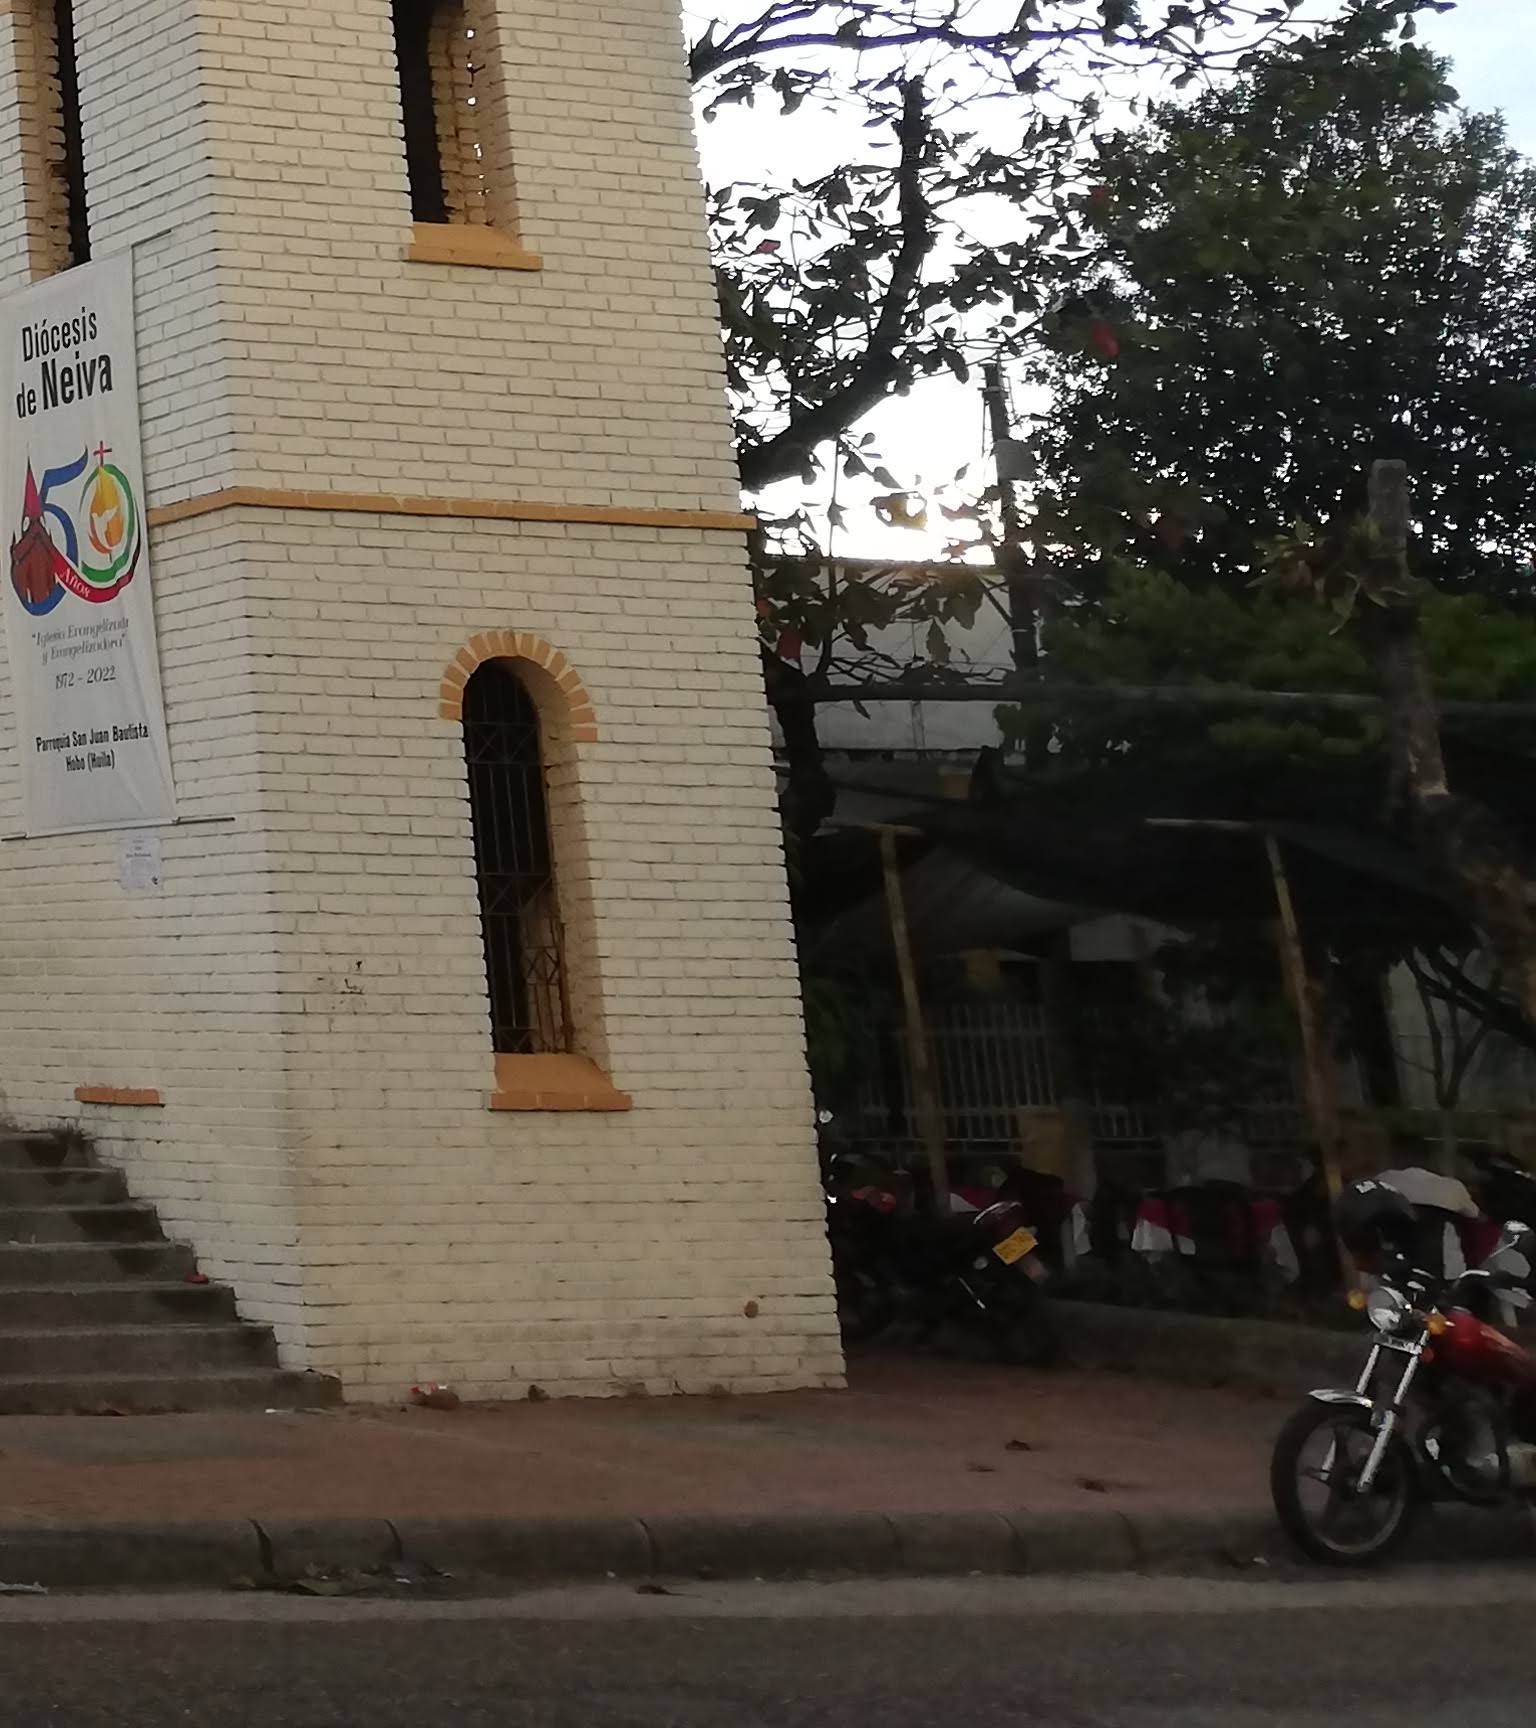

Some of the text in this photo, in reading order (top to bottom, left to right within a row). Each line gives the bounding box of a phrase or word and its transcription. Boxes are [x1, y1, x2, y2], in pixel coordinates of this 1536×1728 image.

[22, 306, 97, 362] Diócesis
[16, 351, 113, 419] de Neiva
[59, 568, 91, 599] Años
[86, 665, 116, 684] 2022
[35, 722, 149, 752] Parroquia San Juan Bautista
[65, 749, 115, 773] Hobo (Huila)
